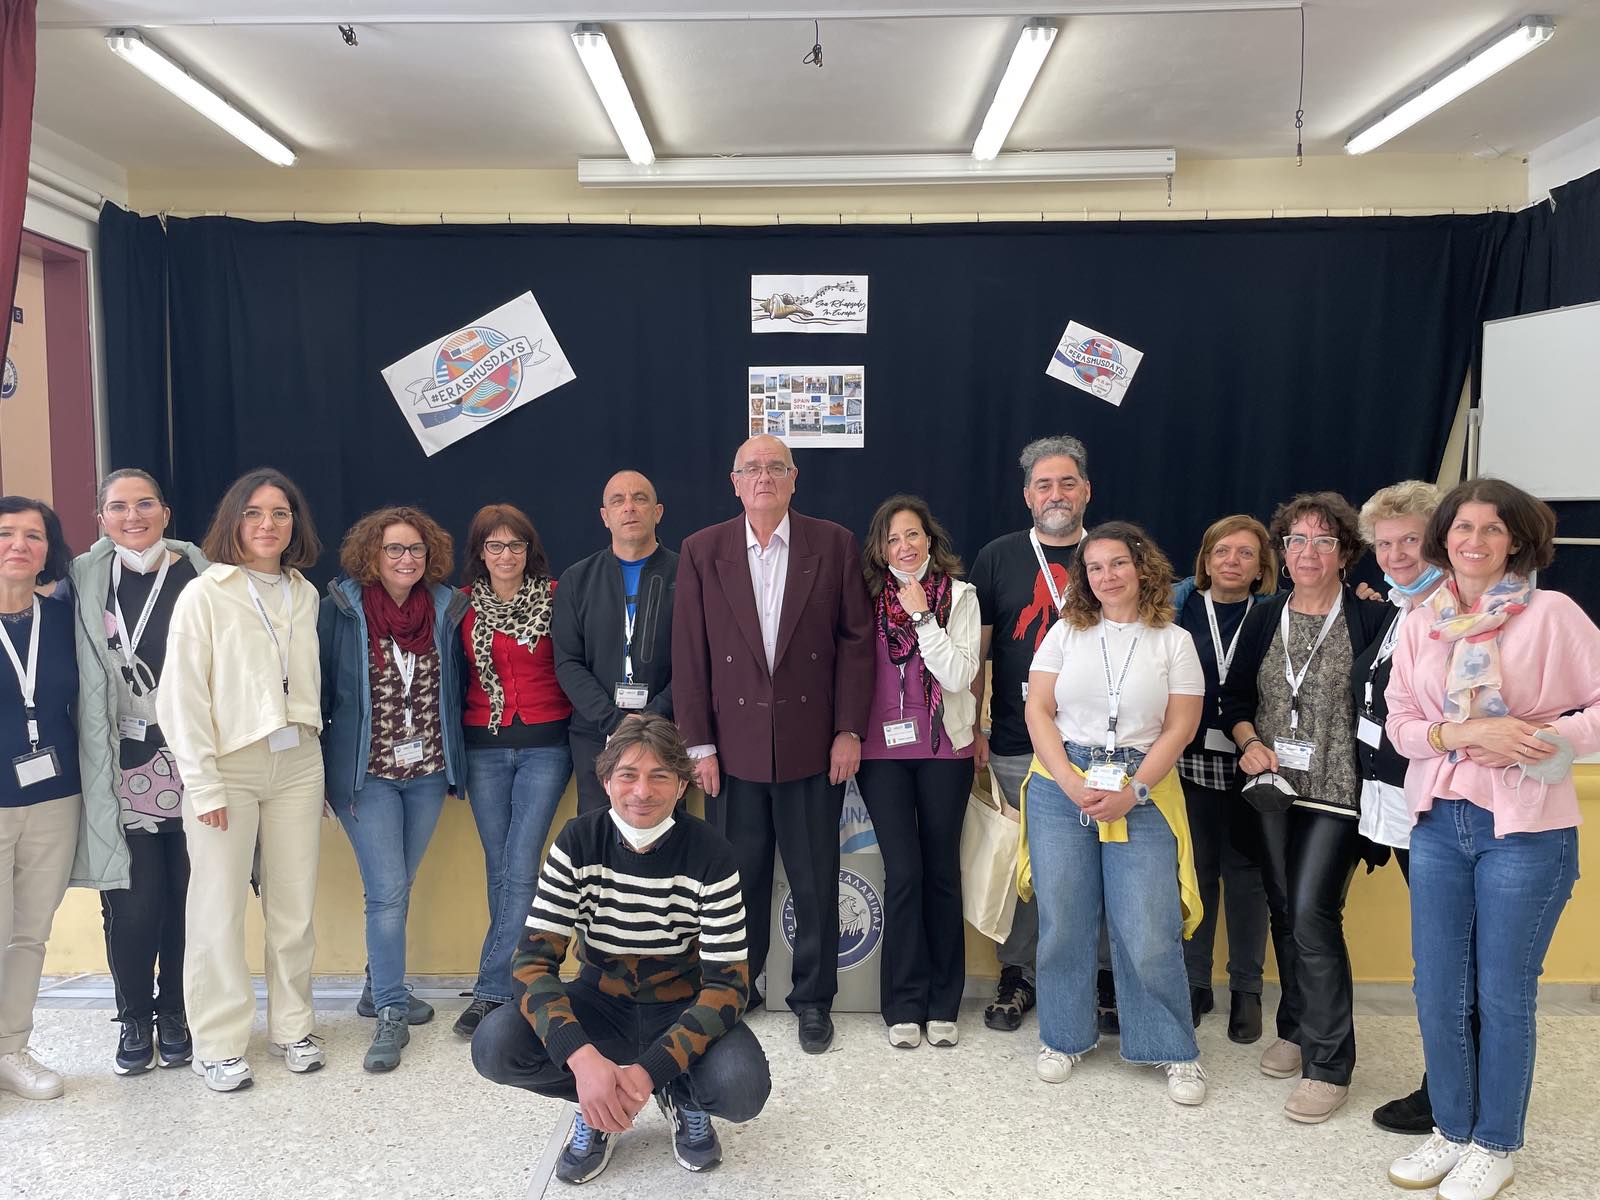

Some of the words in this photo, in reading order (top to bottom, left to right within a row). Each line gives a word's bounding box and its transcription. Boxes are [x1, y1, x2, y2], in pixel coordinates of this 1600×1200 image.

[815, 300, 828, 308] Sea
[830, 299, 866, 312] Rhapsody
[832, 309, 856, 317] Europe
[1068, 349, 1125, 375] #ERASMUSDAYS
[431, 341, 526, 403] #ERASMUSDAYS
